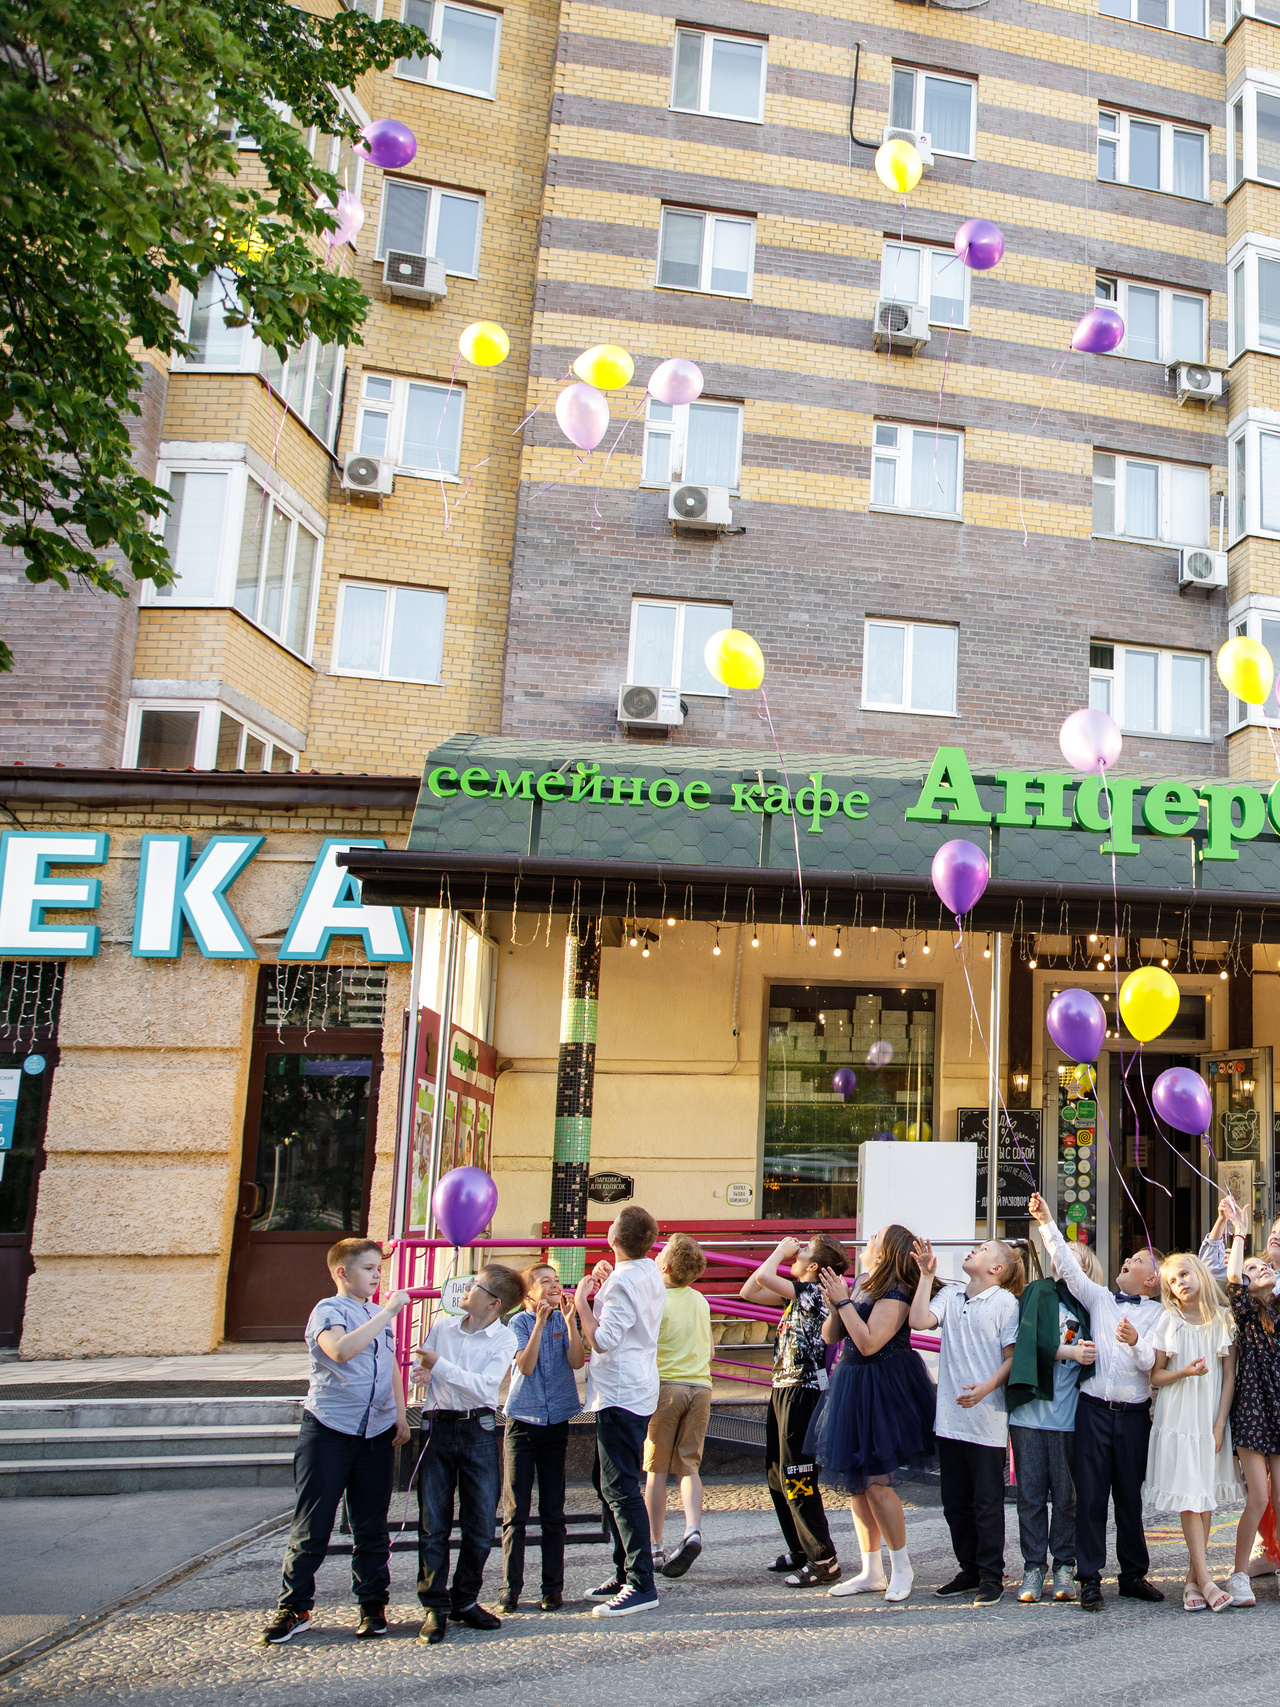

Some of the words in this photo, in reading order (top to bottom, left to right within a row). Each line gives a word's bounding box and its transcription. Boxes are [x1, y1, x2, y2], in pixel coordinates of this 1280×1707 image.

[427, 762, 712, 811] семейное
[731, 772, 870, 833] кафе
[0, 830, 412, 962] ЕКА
